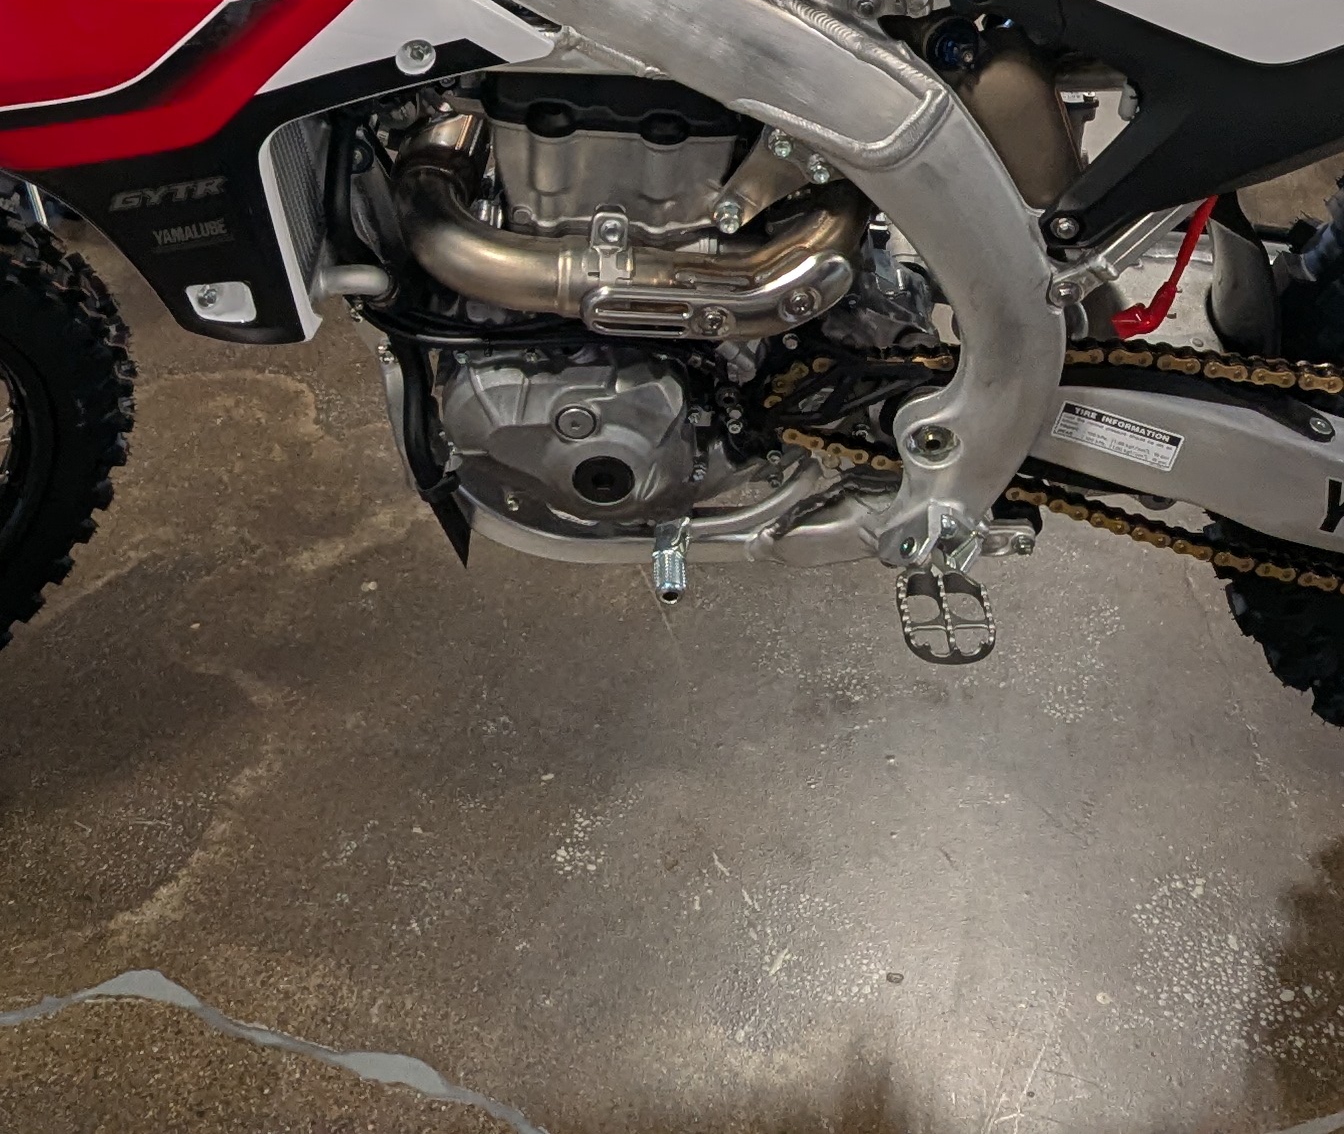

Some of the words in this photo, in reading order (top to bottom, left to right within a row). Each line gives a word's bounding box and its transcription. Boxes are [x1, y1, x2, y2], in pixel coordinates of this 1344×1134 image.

[109, 176, 228, 212] GYTR
[153, 219, 228, 246] YAMALUBE
[1075, 407, 1098, 420] TIRE
[1101, 415, 1171, 443] INFORMATION
